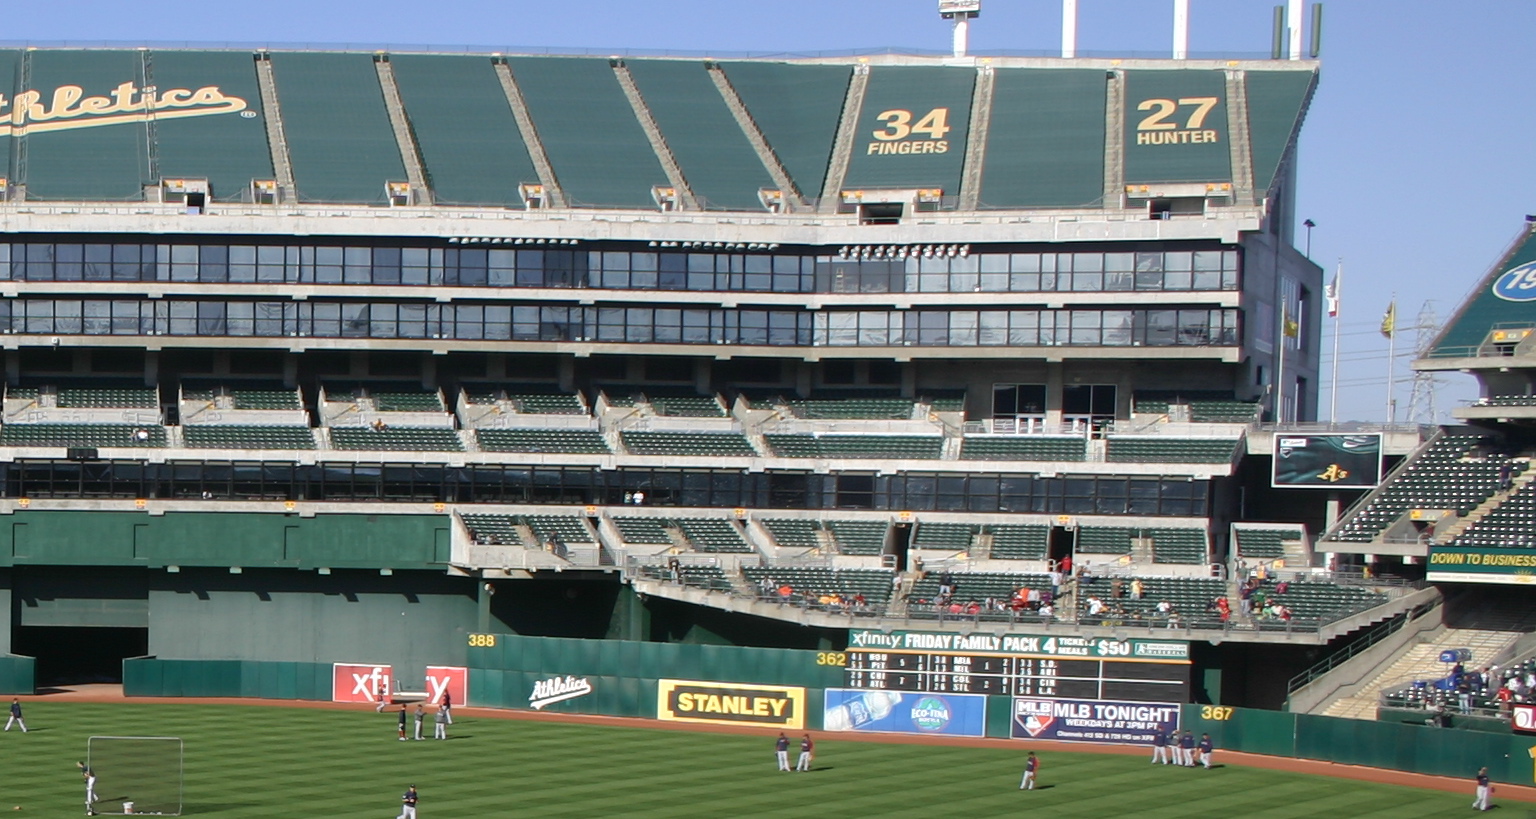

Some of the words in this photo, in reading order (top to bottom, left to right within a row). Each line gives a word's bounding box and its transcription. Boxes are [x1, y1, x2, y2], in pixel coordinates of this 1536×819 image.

[1136, 97, 1218, 131] 27
[872, 108, 950, 141] 34
[1136, 130, 1217, 146] HUNTER
[866, 141, 949, 156] FINGERS
[1316, 464, 1348, 482] A's
[1430, 553, 1465, 565] DOWN
[1466, 553, 1482, 565] TO
[468, 635, 495, 647] 388
[852, 631, 902, 649] xfinity
[904, 633, 952, 649] FRIDAY
[953, 634, 1001, 651] FAMILY
[1003, 637, 1039, 653] PACK
[1042, 637, 1057, 655] 4
[1098, 640, 1130, 656] $50
[816, 652, 846, 666] 362
[528, 675, 592, 707] Athletics
[677, 692, 788, 717] STANLEY
[1017, 701, 1052, 713] MLB
[1054, 702, 1092, 719] MLB
[1094, 704, 1172, 723] TONIGHT
[1201, 705, 1234, 721] 367
[1065, 718, 1113, 728] WEEKDAYS
[1114, 720, 1126, 729] AT
